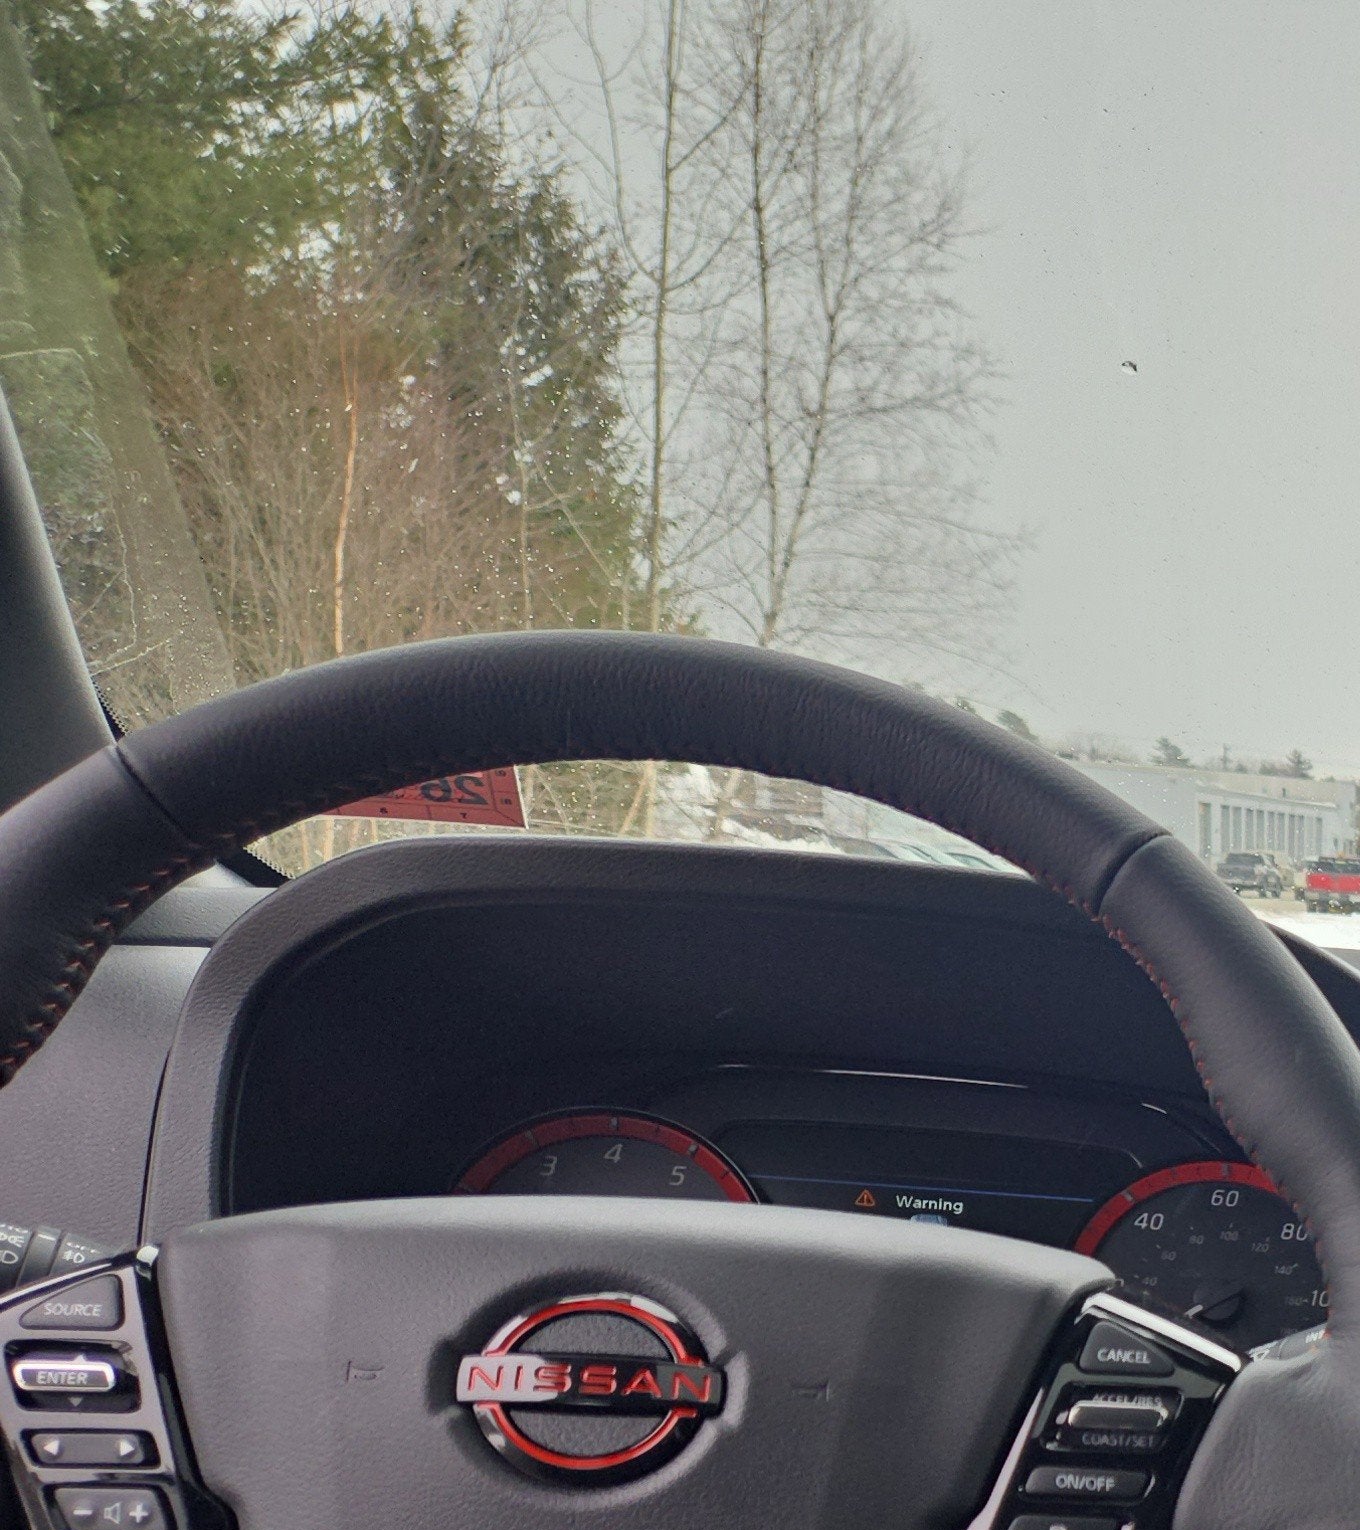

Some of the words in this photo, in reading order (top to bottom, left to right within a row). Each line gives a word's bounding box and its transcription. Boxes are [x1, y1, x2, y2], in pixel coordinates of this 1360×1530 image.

[603, 1143, 622, 1163] 4
[540, 1154, 557, 1176] 3
[669, 1165, 687, 1186] 5
[895, 1194, 964, 1215] Warning
[1210, 1188, 1240, 1207] 60
[1133, 1212, 1164, 1231] 40
[43, 1302, 103, 1317] SOURCE
[1097, 1348, 1151, 1364] CANCEL
[35, 1370, 88, 1385] ENTER
[466, 1363, 712, 1402] NISSAN
[1081, 1432, 1155, 1447] COAST/SET
[1055, 1474, 1115, 1492] ON/OFF
